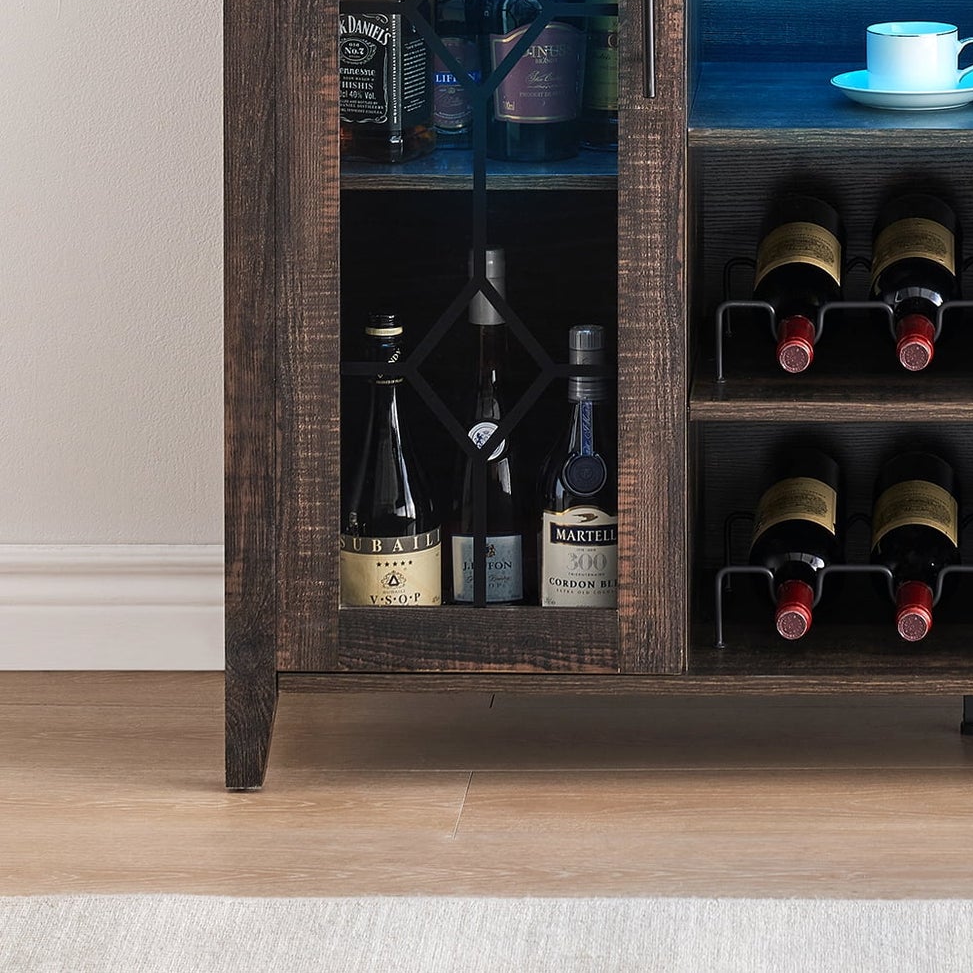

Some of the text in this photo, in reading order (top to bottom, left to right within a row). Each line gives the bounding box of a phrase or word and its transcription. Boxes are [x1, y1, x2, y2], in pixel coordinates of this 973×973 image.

[347, 15, 392, 46] DANIEL'S
[556, 528, 617, 542] MARTELL
[567, 553, 608, 571] 300
[548, 577, 595, 589] CORDON
